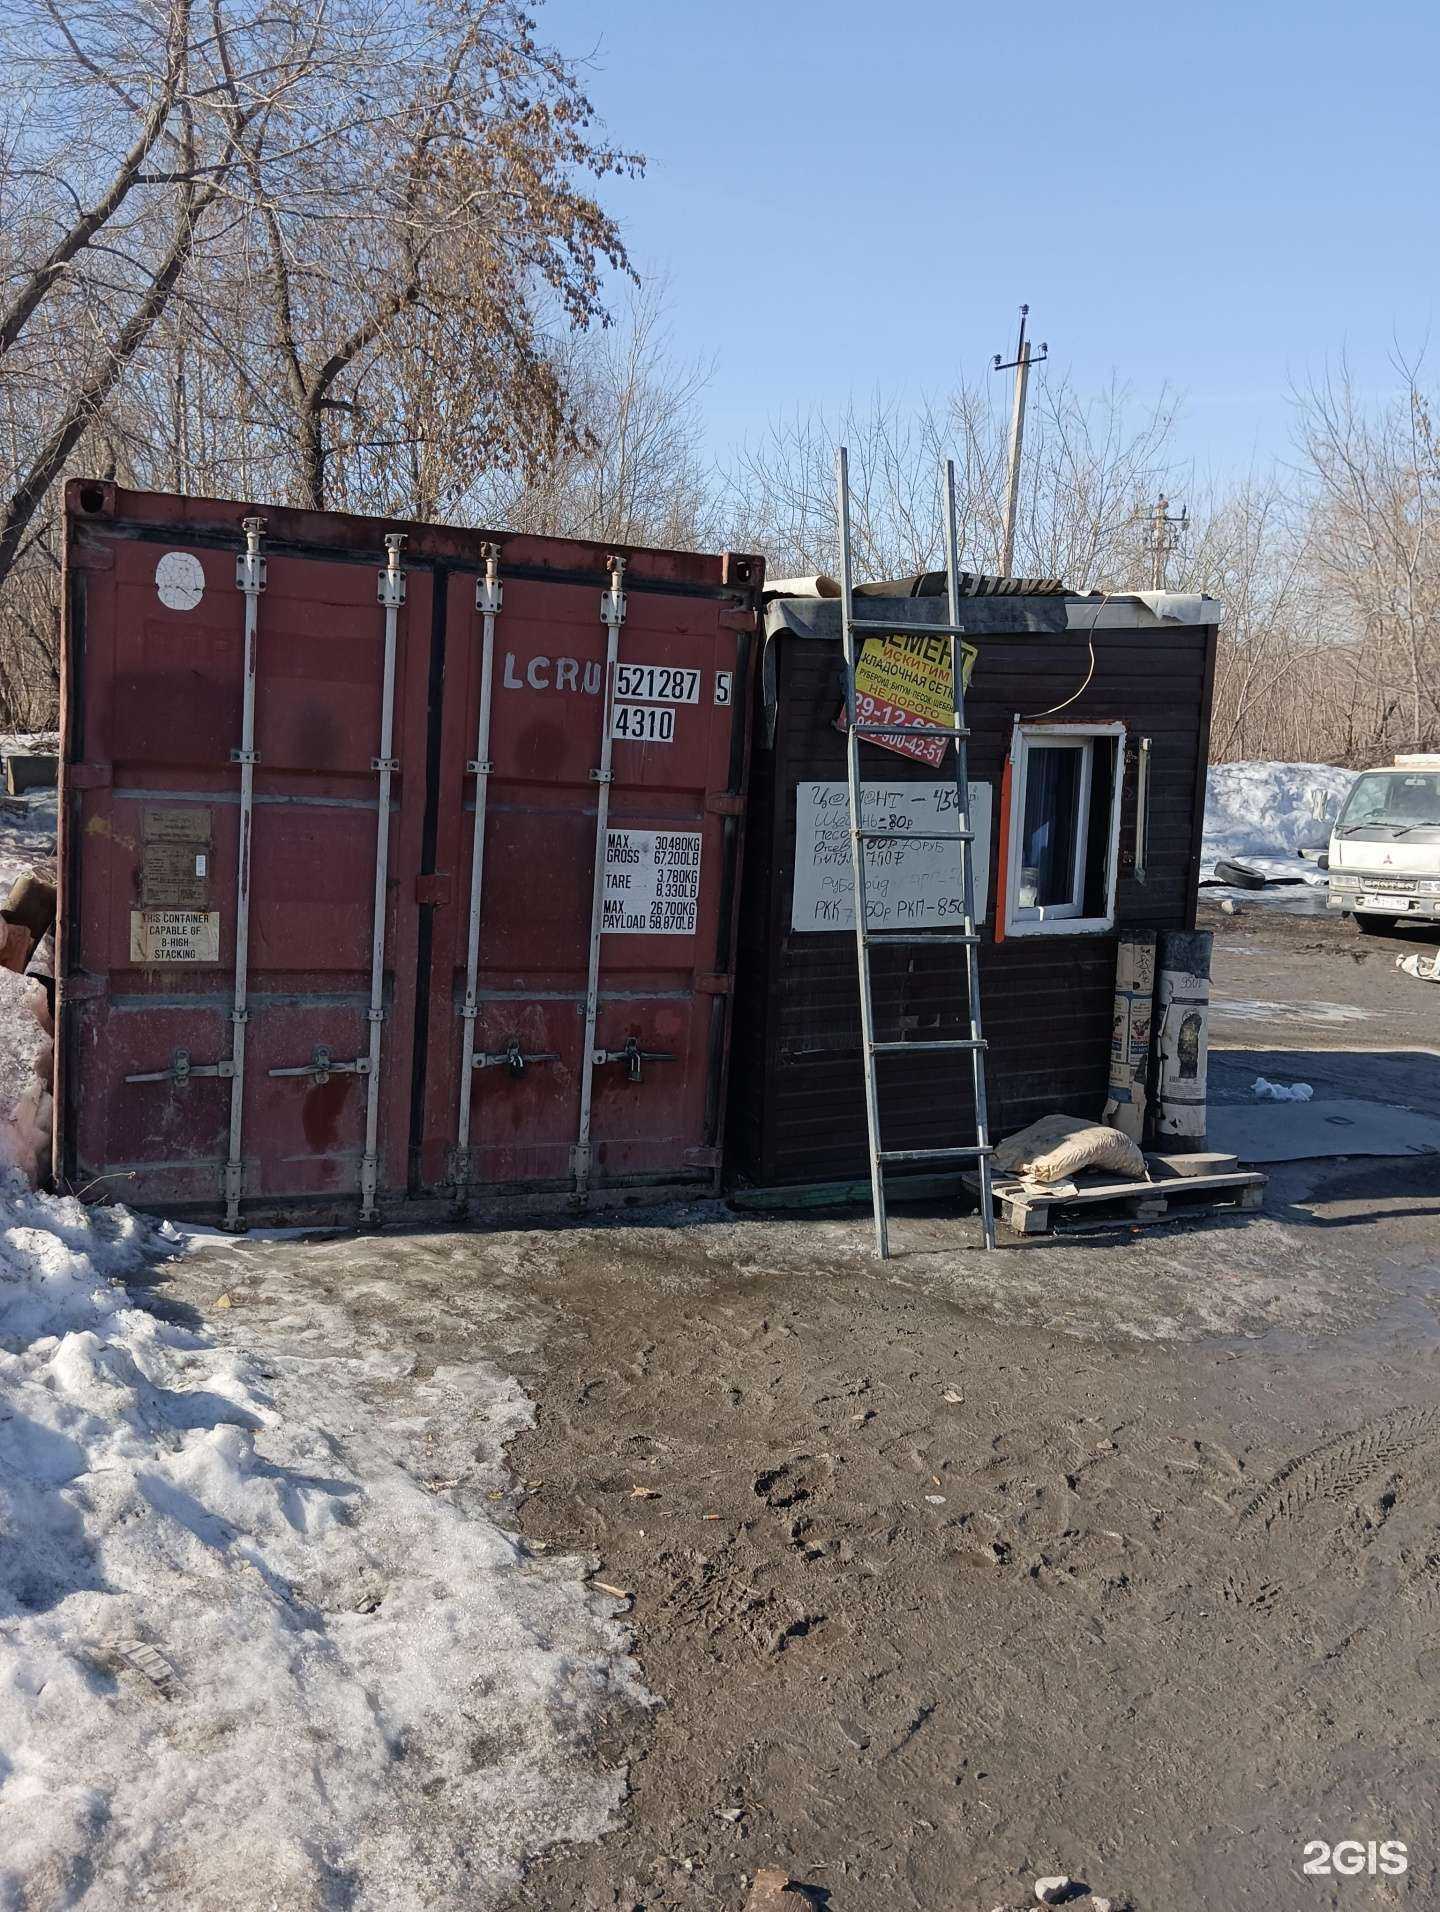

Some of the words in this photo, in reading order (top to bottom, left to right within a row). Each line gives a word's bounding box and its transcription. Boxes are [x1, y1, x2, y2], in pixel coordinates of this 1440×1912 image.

[882, 633, 974, 670] ЕМЕНТ
[883, 646, 950, 682] ИСКИТИМ
[503, 652, 601, 695] LCRU
[617, 667, 698, 700] 521287
[716, 673, 729, 702] 5
[861, 652, 927, 687] КЛАДОЧНАЯ
[928, 680, 954, 699] СЕТК
[869, 683, 885, 698] НЕ
[887, 693, 940, 719] ДОРОГО
[615, 708, 673, 740] 4310
[607, 833, 632, 849] MAX.
[655, 836, 700, 851] 30,480KG
[606, 849, 640, 864] GROSS
[654, 851, 699, 865] 67,200LB
[606, 874, 632, 889] TARE
[657, 869, 698, 883] 3,780KG
[656, 883, 697, 898] 8,330LB
[650, 901, 695, 916] 26,700KG
[142, 913, 161, 923] THIS
[163, 914, 209, 923] CONTAINER
[602, 915, 646, 928] PAYLOAD
[649, 916, 694, 930] 58,870LB
[149, 926, 188, 935] CAPABLE
[161, 938, 189, 947] 8-HIGH
[154, 950, 196, 959] STACKING
